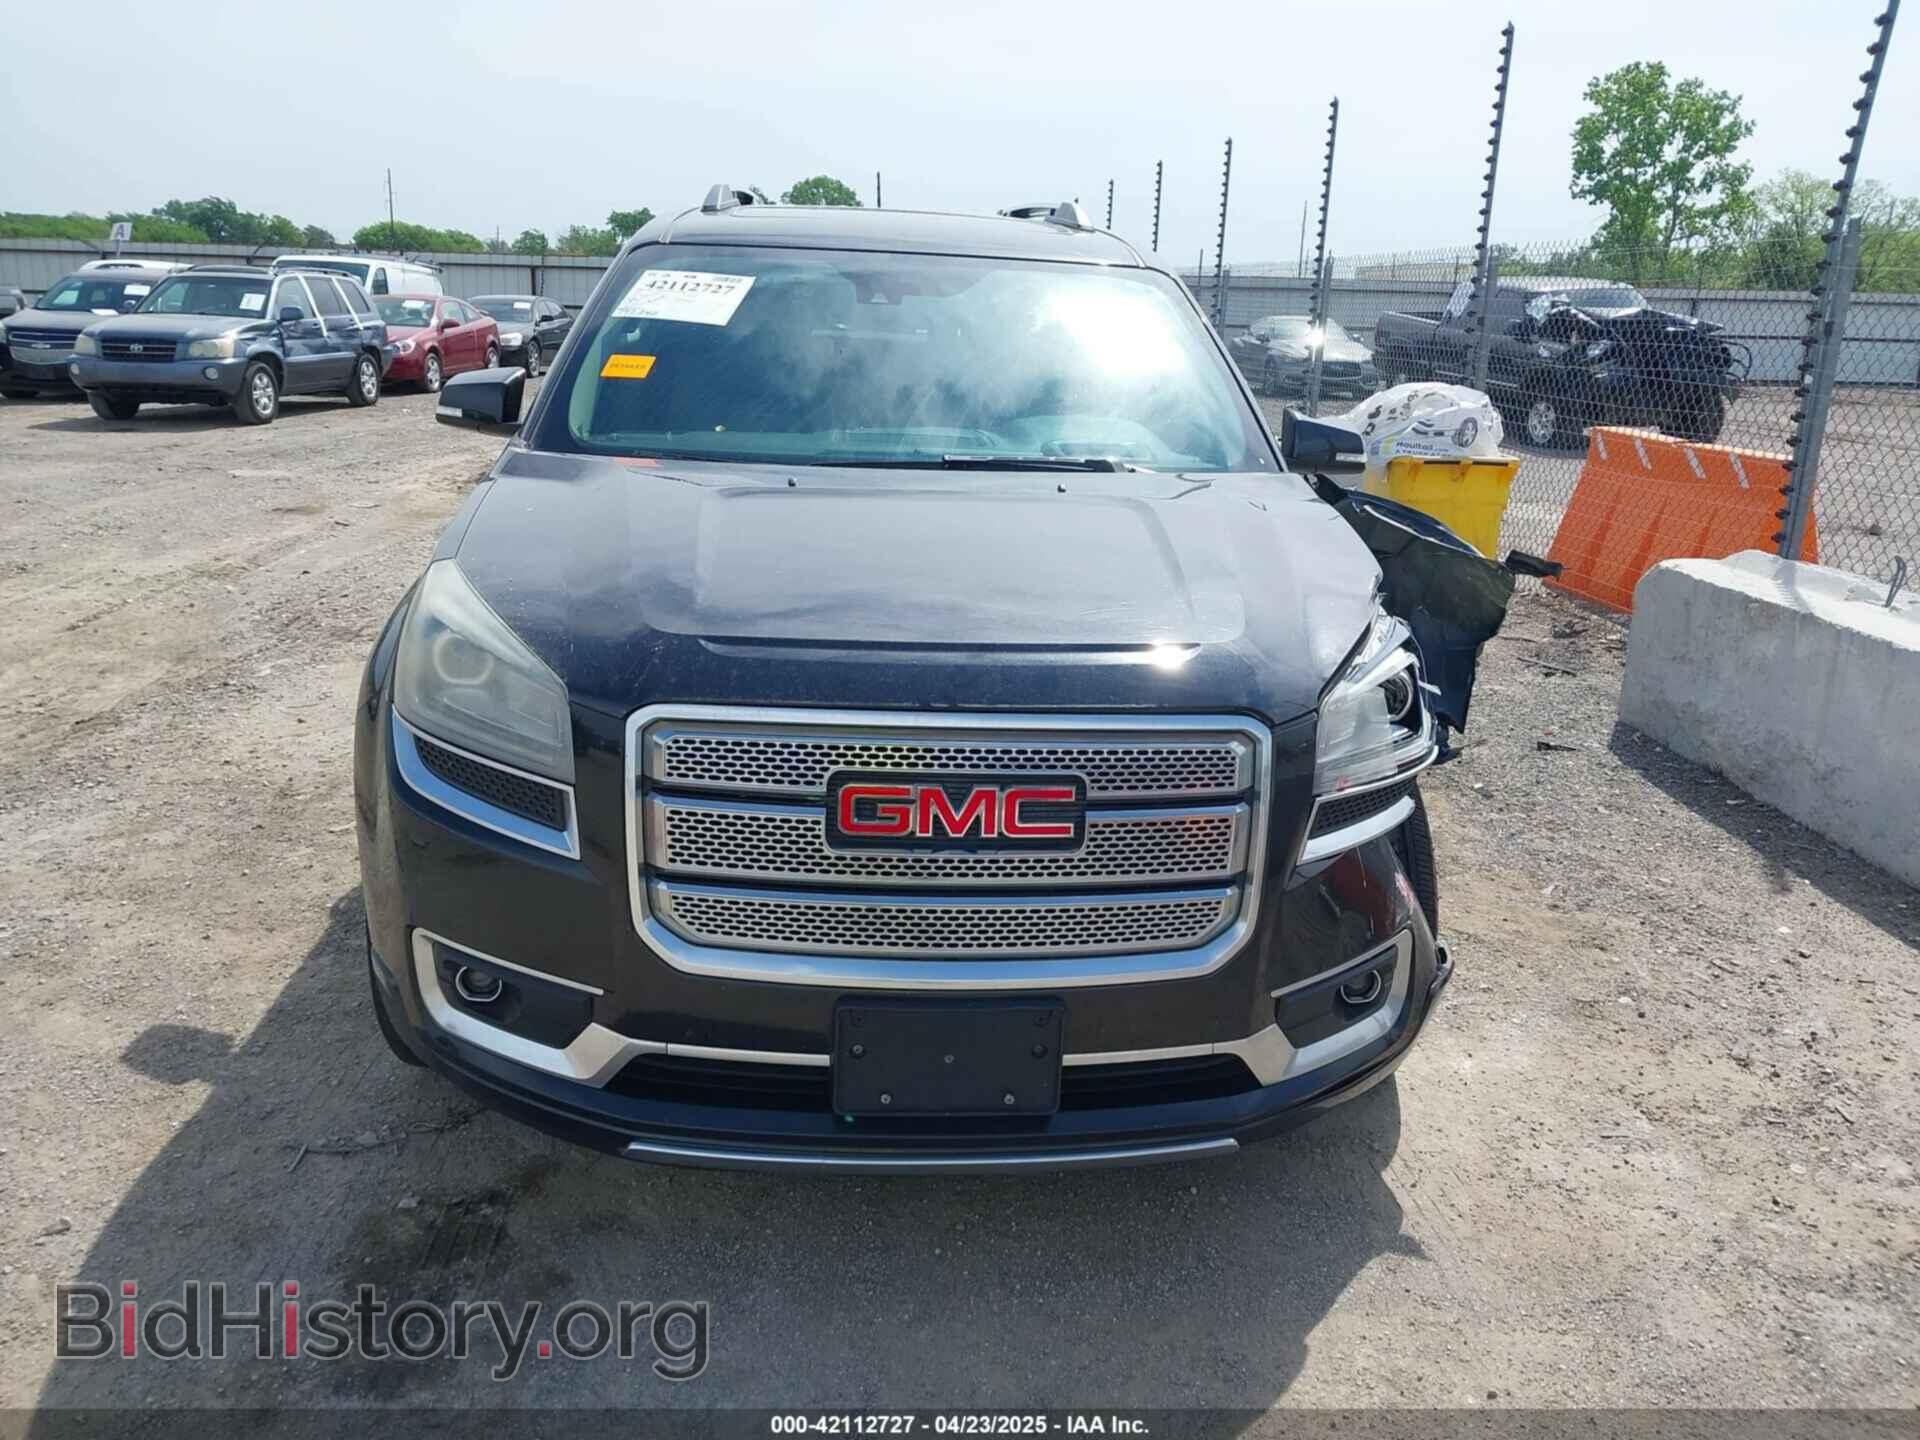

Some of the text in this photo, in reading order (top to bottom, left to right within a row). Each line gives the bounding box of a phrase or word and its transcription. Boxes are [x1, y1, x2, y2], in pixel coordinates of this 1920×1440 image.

[114, 224, 124, 238] A
[646, 279, 736, 295] 42112727
[838, 783, 1077, 839] GMC
